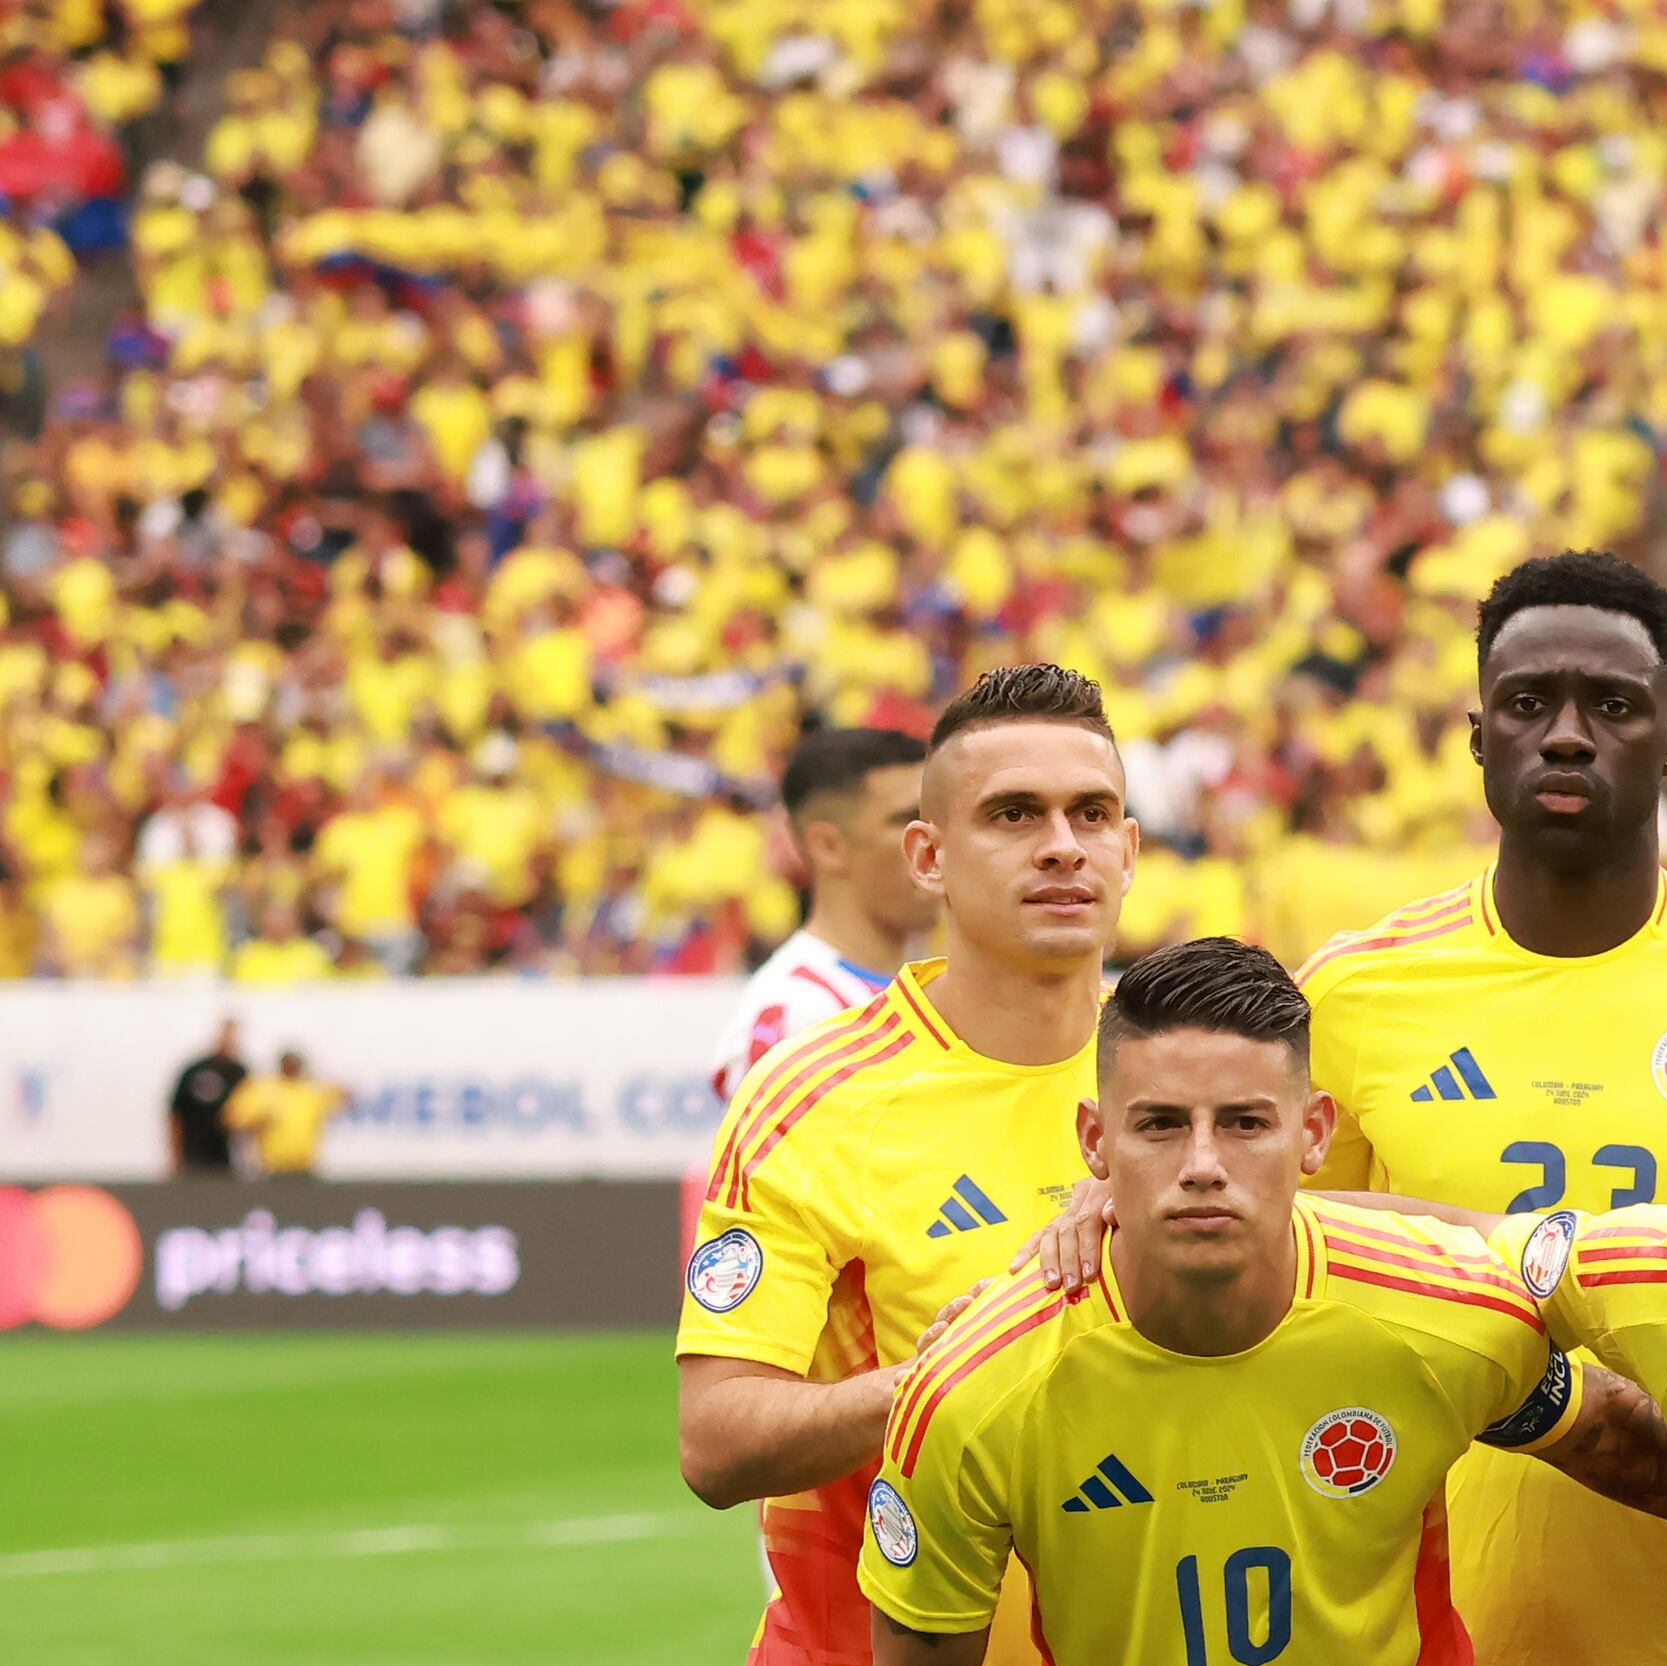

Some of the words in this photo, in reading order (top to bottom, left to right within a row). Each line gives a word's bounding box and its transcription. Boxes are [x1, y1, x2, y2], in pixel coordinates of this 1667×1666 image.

[155, 1206, 520, 1310] priceless
[1328, 1410, 1373, 1423] COLOMBIANA
[1380, 1424, 1393, 1446] FUTBOL
